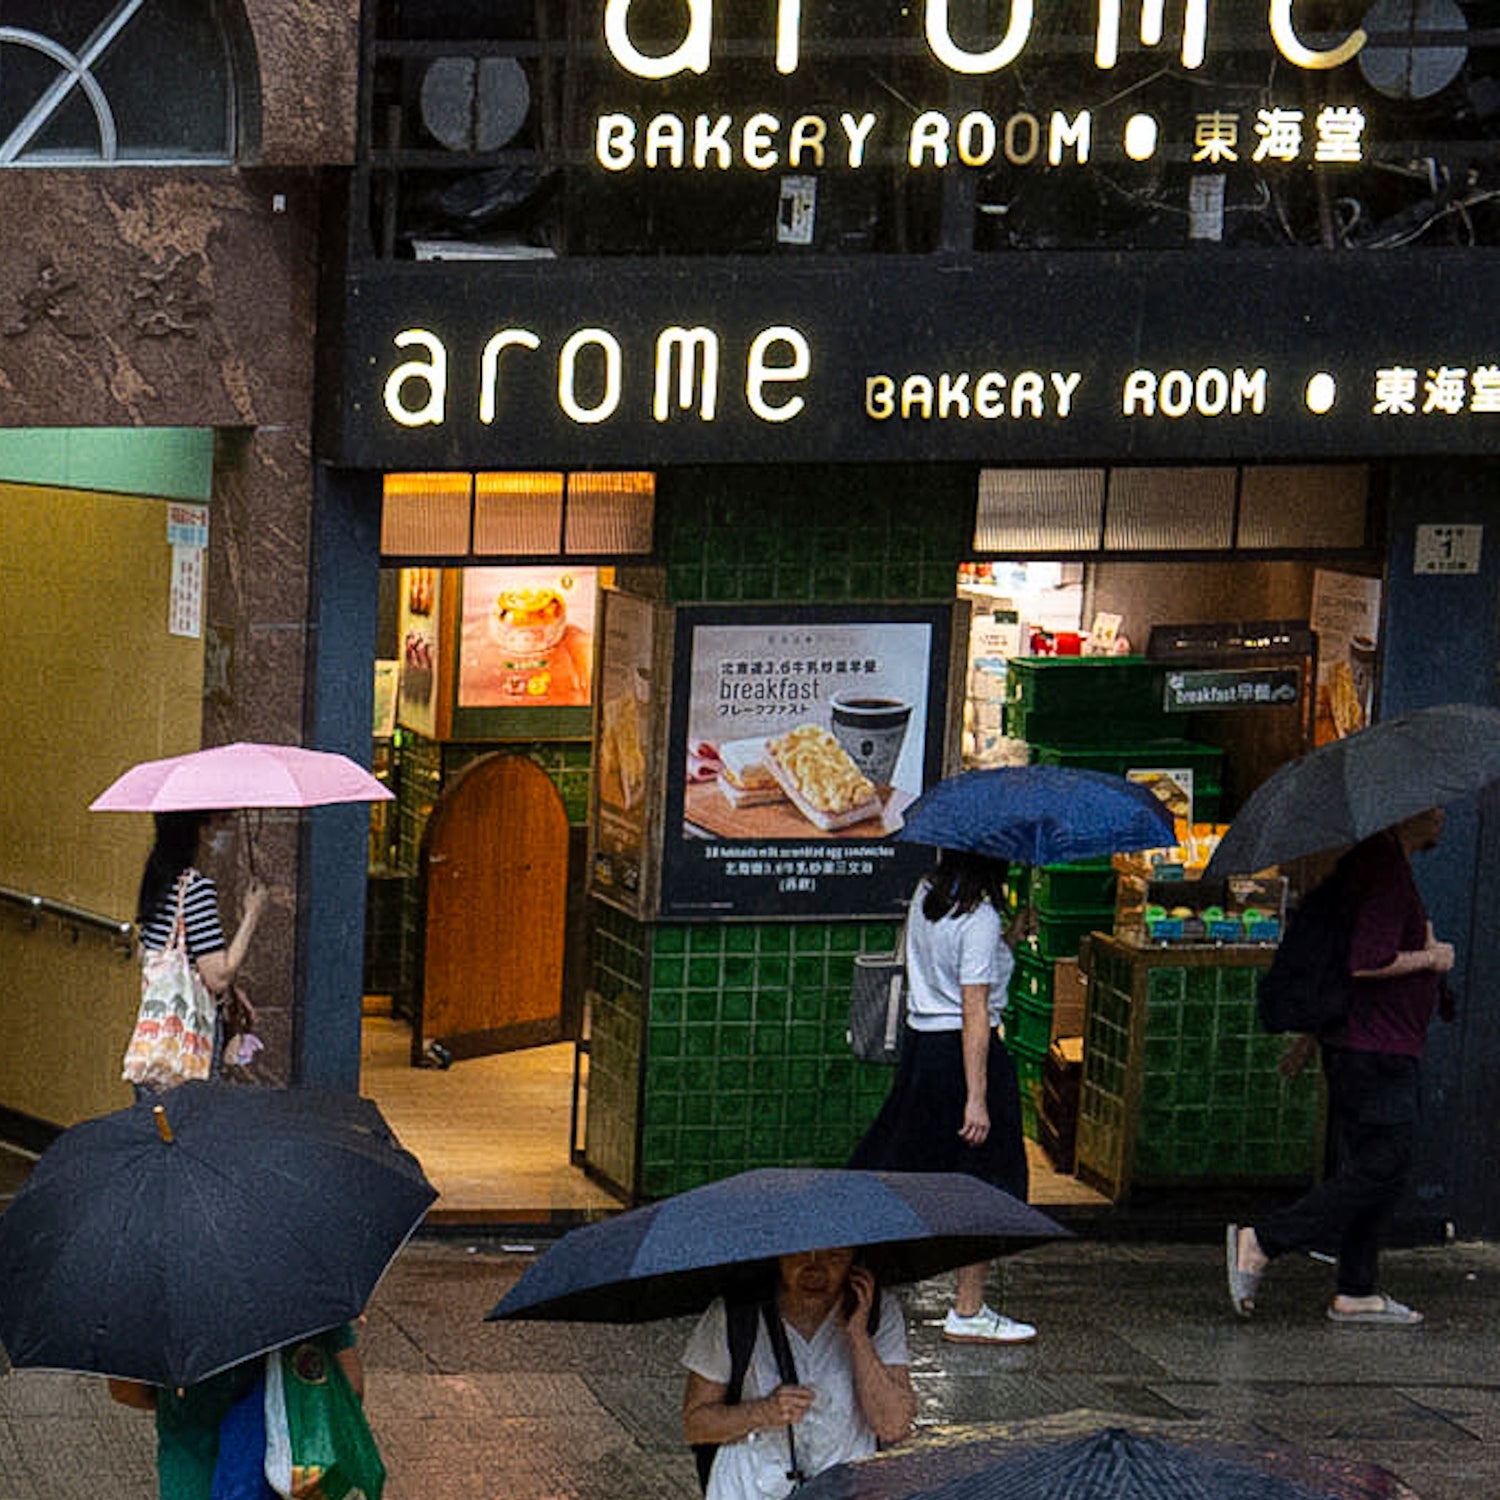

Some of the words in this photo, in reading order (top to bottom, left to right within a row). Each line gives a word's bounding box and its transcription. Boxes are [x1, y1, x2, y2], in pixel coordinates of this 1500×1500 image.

[596, 112, 876, 171] BAKERY
[908, 110, 1091, 168] ROOM
[1193, 107, 1366, 163] 東海堂
[383, 325, 812, 427] arome
[865, 371, 1081, 419] BAKERY
[1123, 368, 1267, 417] ROOM
[1373, 365, 1500, 414] 東海堂
[720, 678, 820, 700] breakfast
